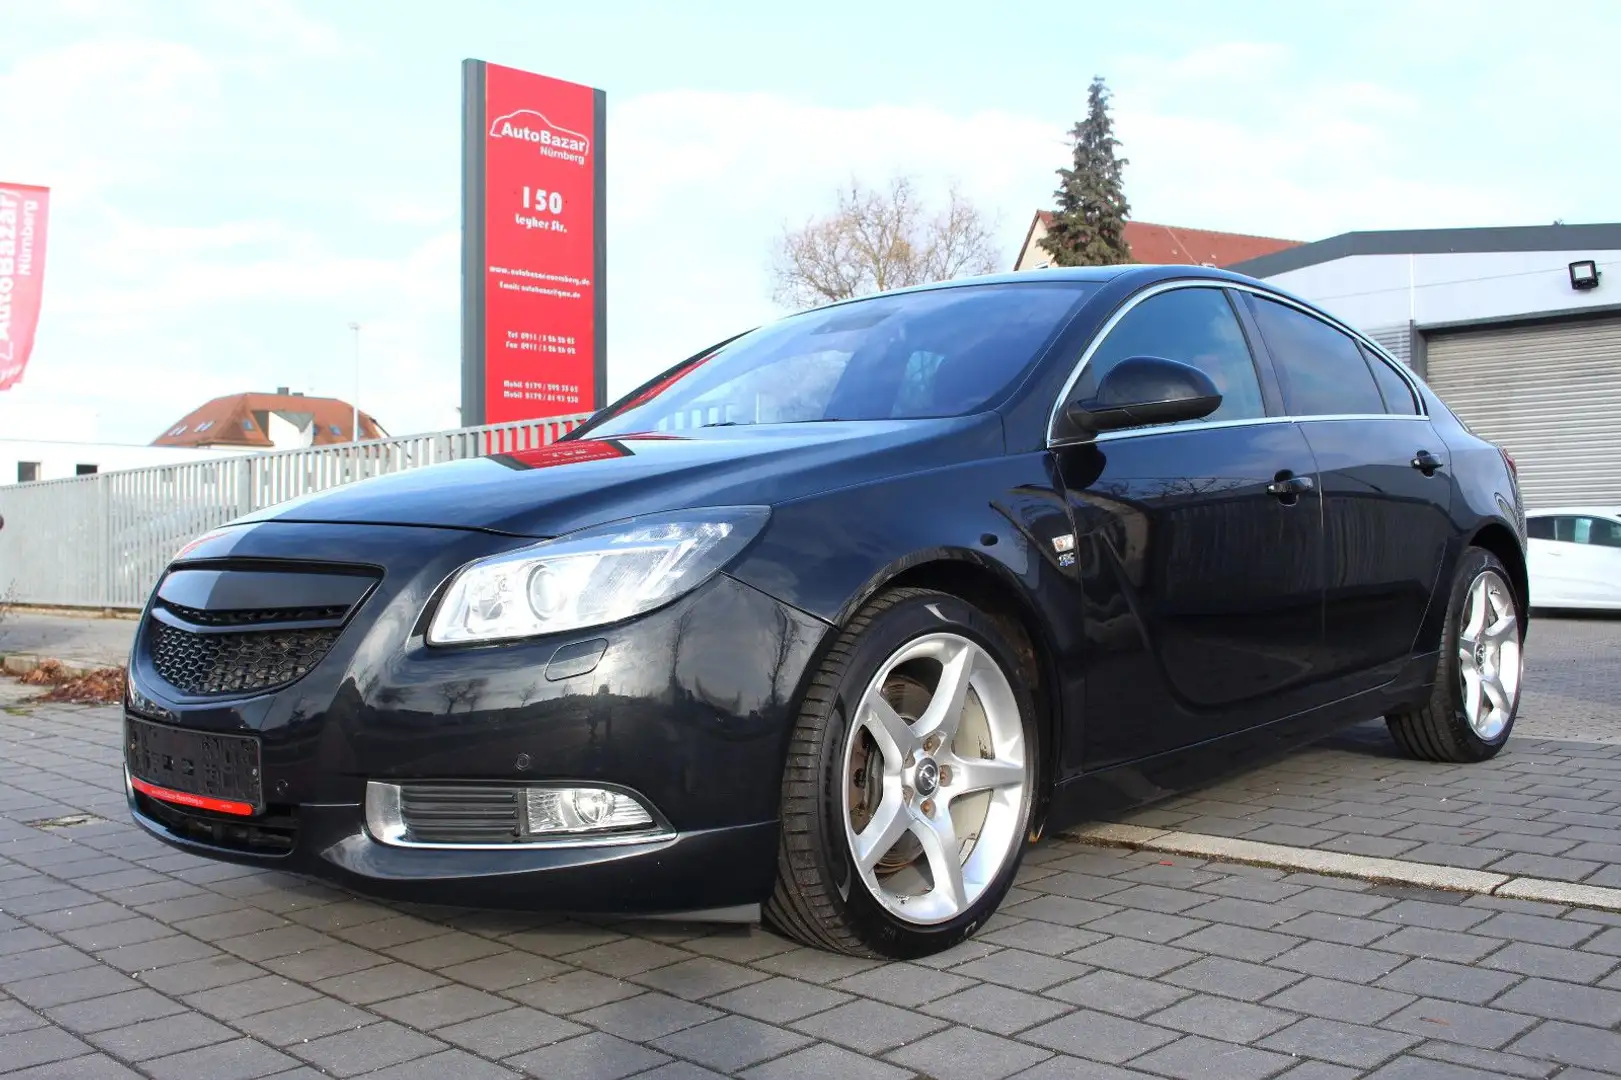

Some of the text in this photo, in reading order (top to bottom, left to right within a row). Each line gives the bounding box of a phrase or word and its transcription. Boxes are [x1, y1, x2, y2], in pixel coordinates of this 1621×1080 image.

[501, 122, 585, 152] AutoBazar
[540, 146, 585, 166] Nürnberg
[523, 186, 562, 214] 150
[18, 200, 39, 276] Nürnberg
